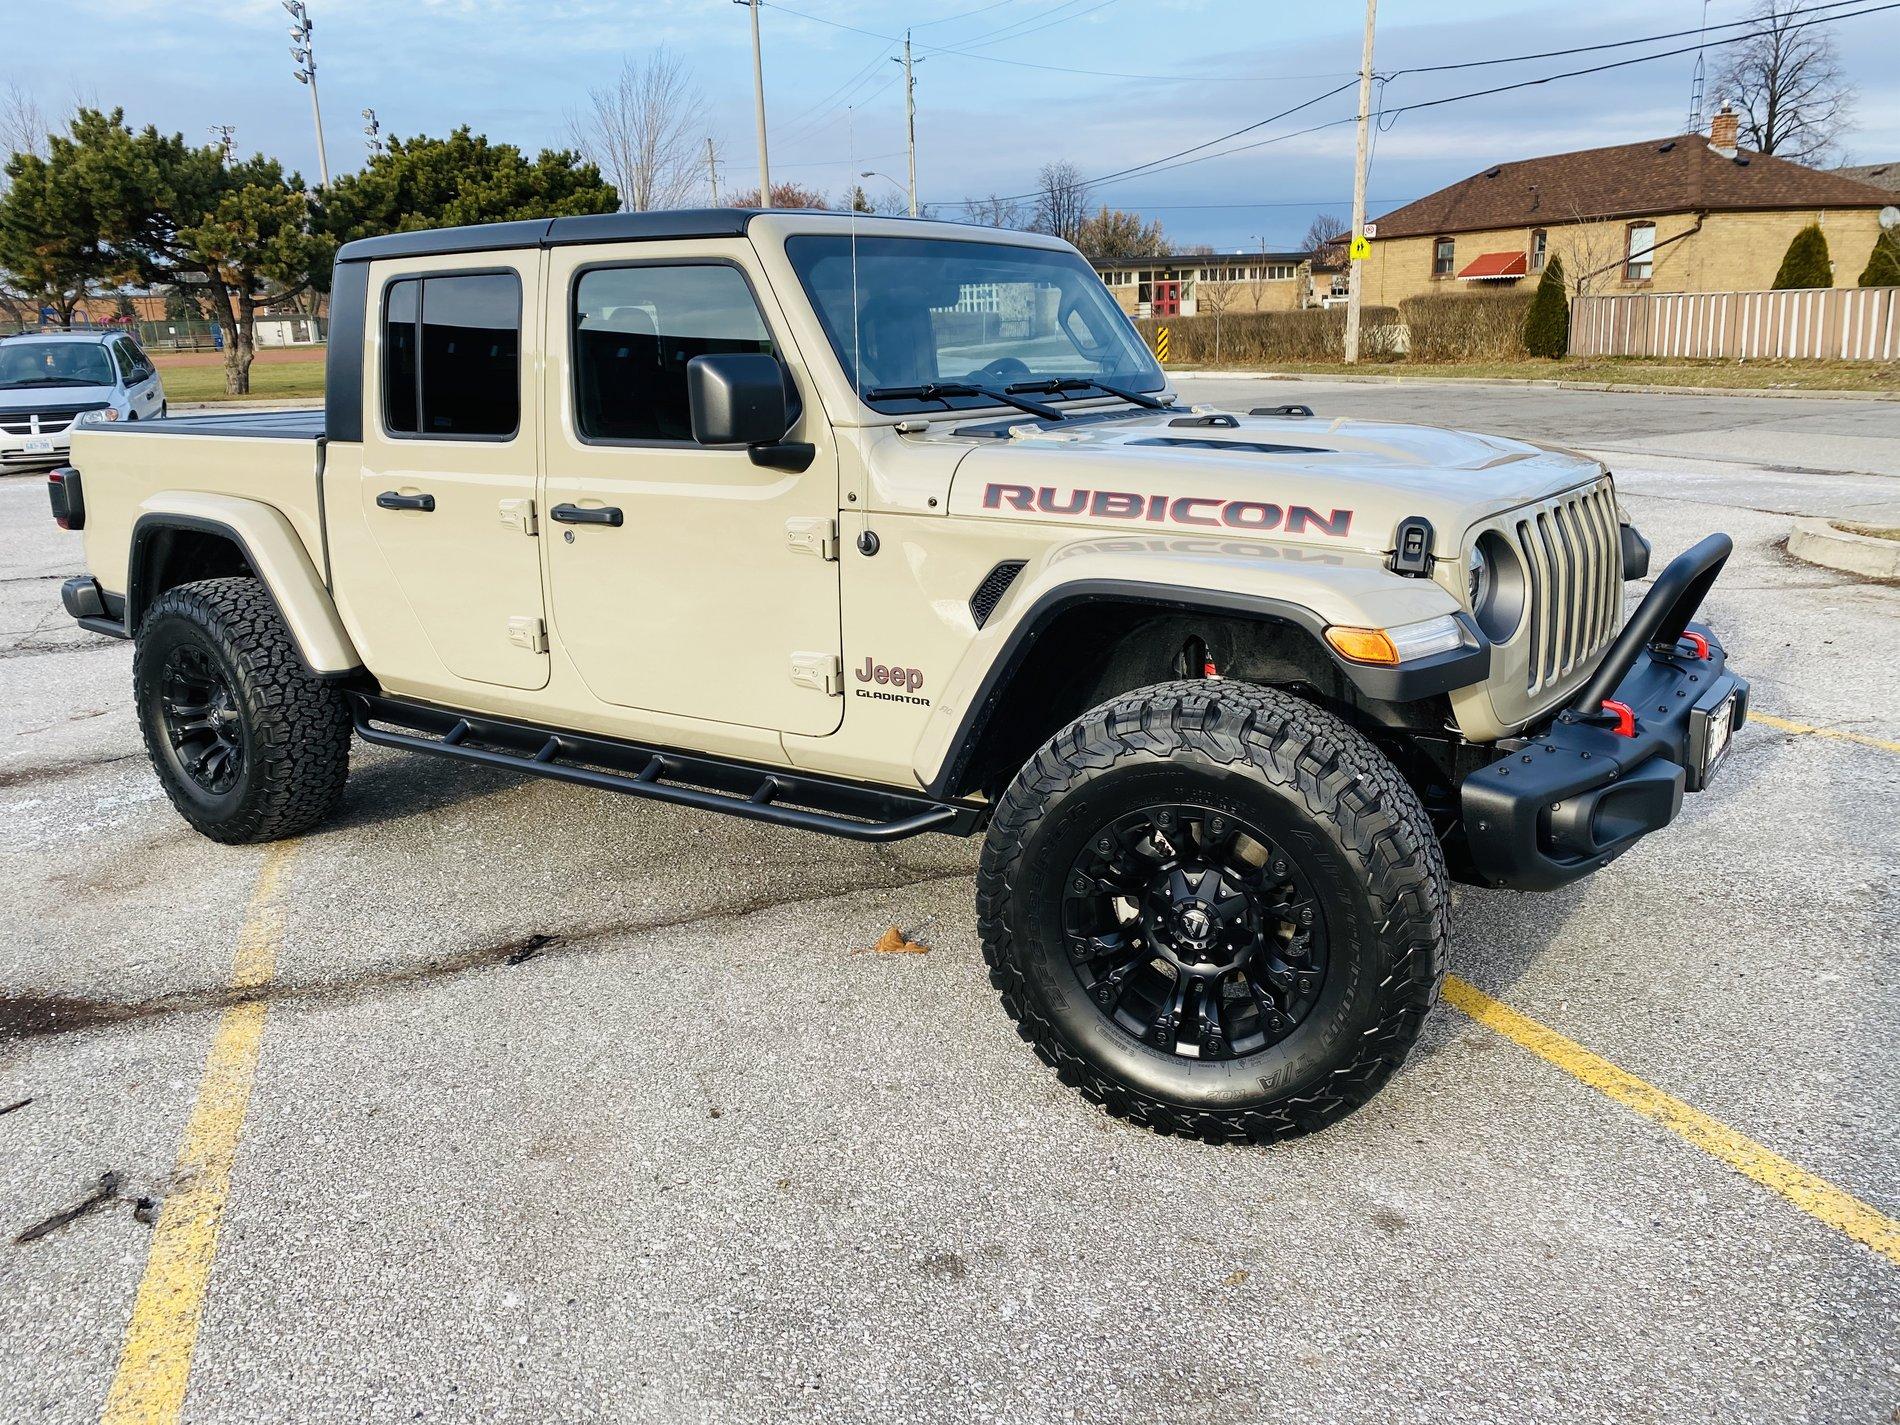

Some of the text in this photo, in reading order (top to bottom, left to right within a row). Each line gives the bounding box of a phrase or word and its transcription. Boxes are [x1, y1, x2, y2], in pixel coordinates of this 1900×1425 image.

[983, 483, 1353, 537] RUBICON
[855, 656, 924, 693] Jeep
[856, 689, 930, 706] GLADIATOR
